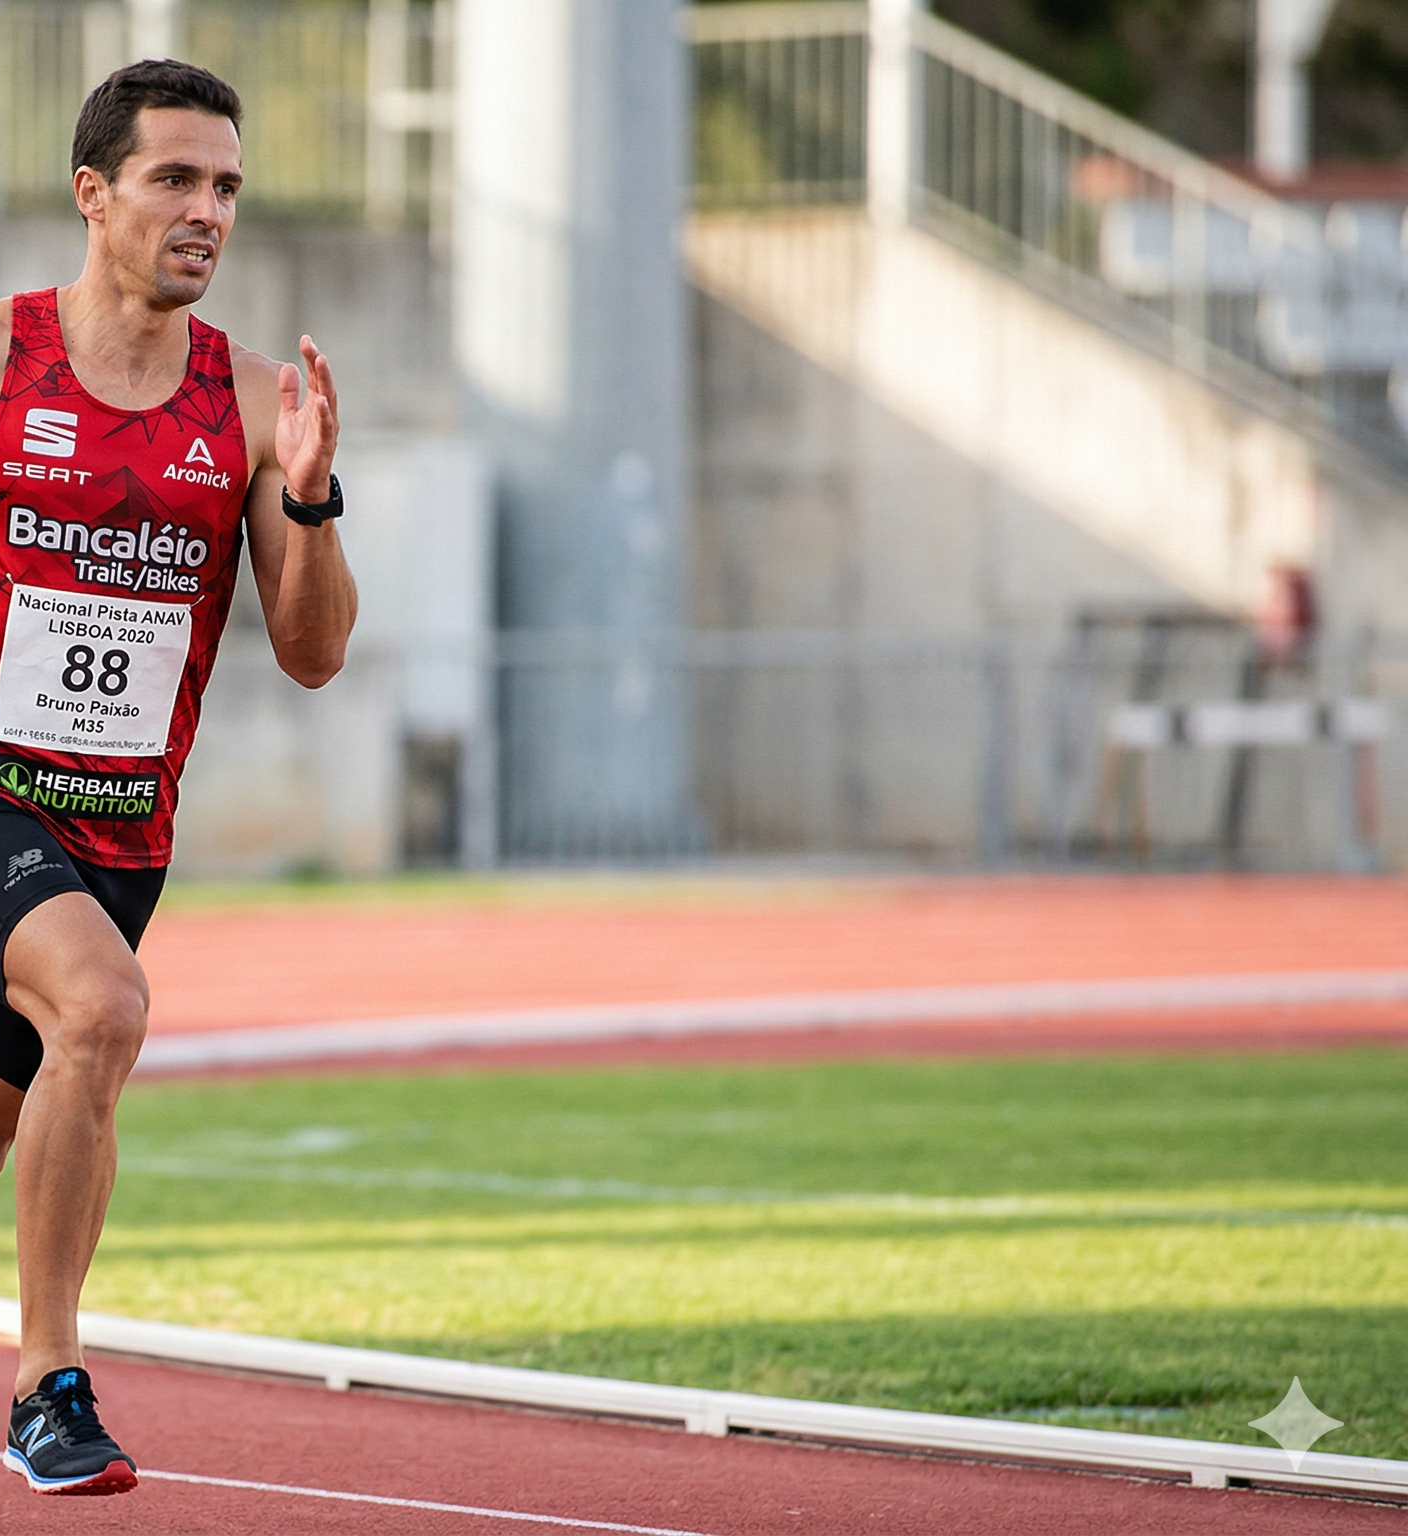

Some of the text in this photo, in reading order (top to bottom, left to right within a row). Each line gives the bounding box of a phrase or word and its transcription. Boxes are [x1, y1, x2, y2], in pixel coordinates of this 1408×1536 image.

[2, 461, 92, 486] SEAT
[162, 463, 231, 490] Aronick
[8, 507, 207, 567] Bancaléio
[74, 558, 199, 592] Trails/Bikes
[18, 592, 186, 626] Nacional Pista ANAV
[48, 619, 155, 644] LISBOA 2020
[61, 644, 131, 697] 88
[35, 693, 140, 718] Bruno Paixão
[71, 717, 105, 734] M35
[35, 769, 157, 798] HERBALIFE
[32, 786, 154, 815] NUTRITION
[18, 1412, 57, 1458] N
